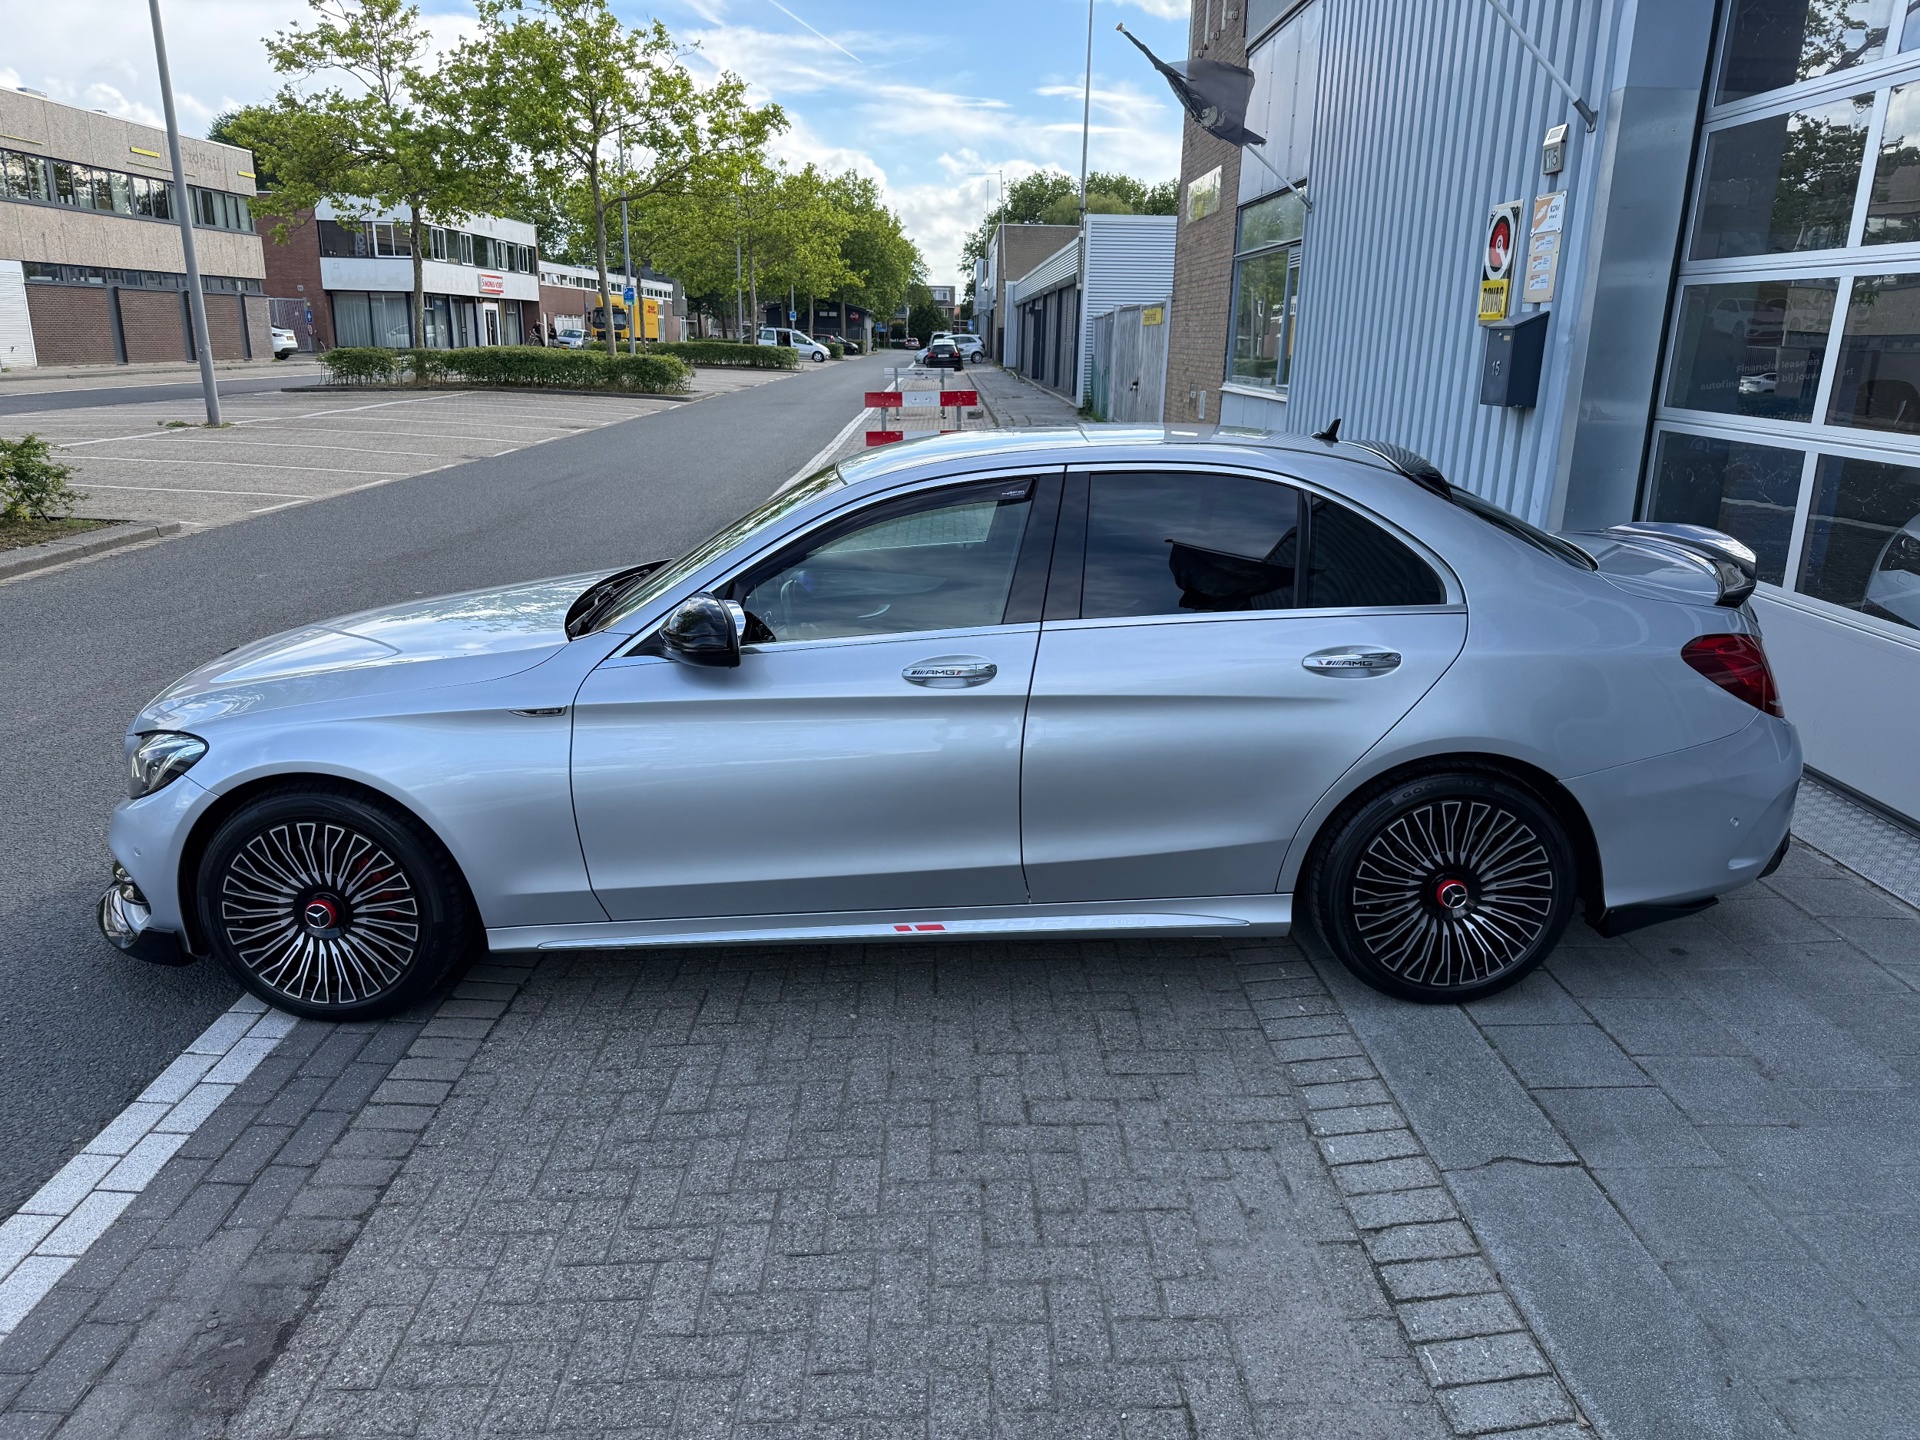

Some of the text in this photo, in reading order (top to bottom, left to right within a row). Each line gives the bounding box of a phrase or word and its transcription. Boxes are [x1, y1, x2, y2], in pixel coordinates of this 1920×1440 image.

[1546, 149, 1558, 169] 15
[1481, 286, 1504, 313] BOVAG
[1491, 360, 1501, 376] 15
[1781, 359, 1806, 370] lease
[1808, 358, 1819, 367] en
[1781, 374, 1794, 384] bij
